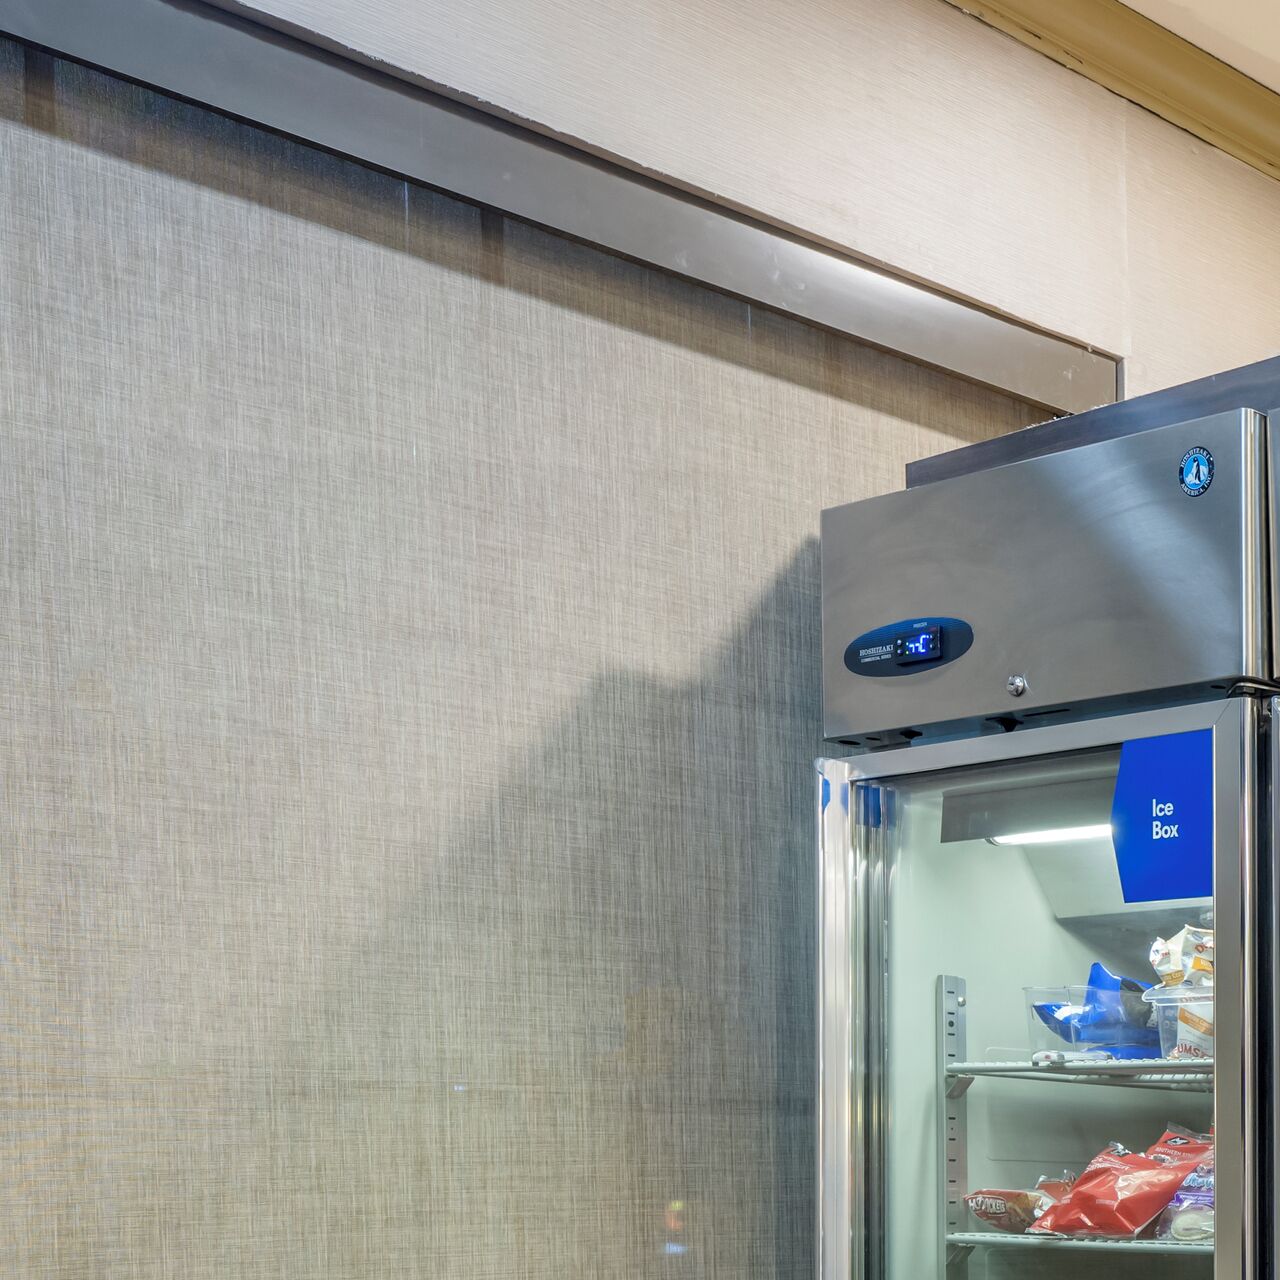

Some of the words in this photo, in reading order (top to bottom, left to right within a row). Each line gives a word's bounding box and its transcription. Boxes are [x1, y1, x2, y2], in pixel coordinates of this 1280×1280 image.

[859, 644, 893, 656] HOSHIZAKI
[1152, 799, 1174, 817] Ice
[1152, 822, 1178, 839] Box
